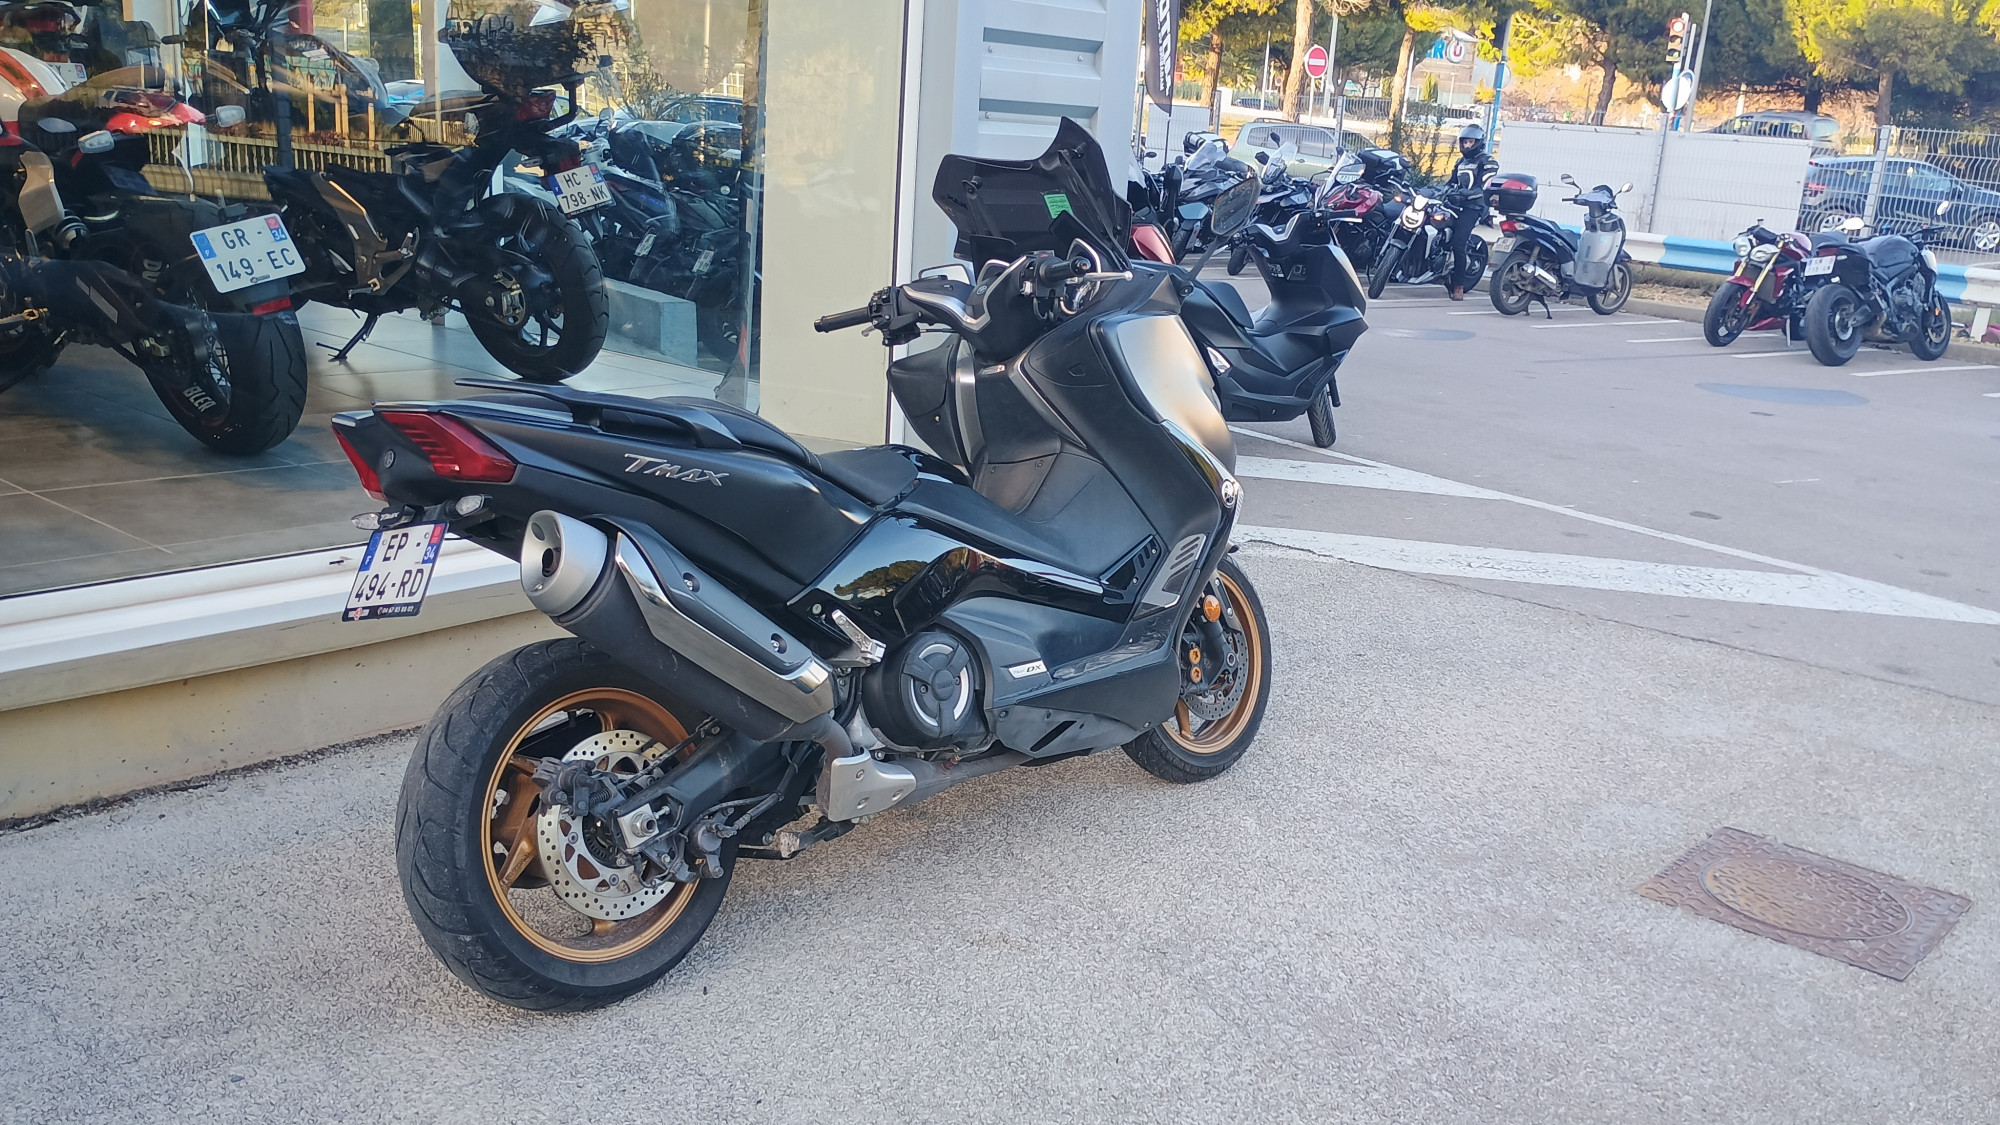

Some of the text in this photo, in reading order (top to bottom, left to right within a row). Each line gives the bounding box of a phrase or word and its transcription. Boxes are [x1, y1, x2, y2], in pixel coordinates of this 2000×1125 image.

[563, 172, 581, 188] HC
[561, 185, 608, 210] 798-NK
[221, 228, 250, 250] GR
[271, 228, 286, 241] 34
[216, 247, 295, 282] 149-EC
[624, 453, 730, 487] TMAX
[382, 532, 409, 562] EP
[423, 545, 436, 560] 34
[354, 568, 425, 602] 494-RD
